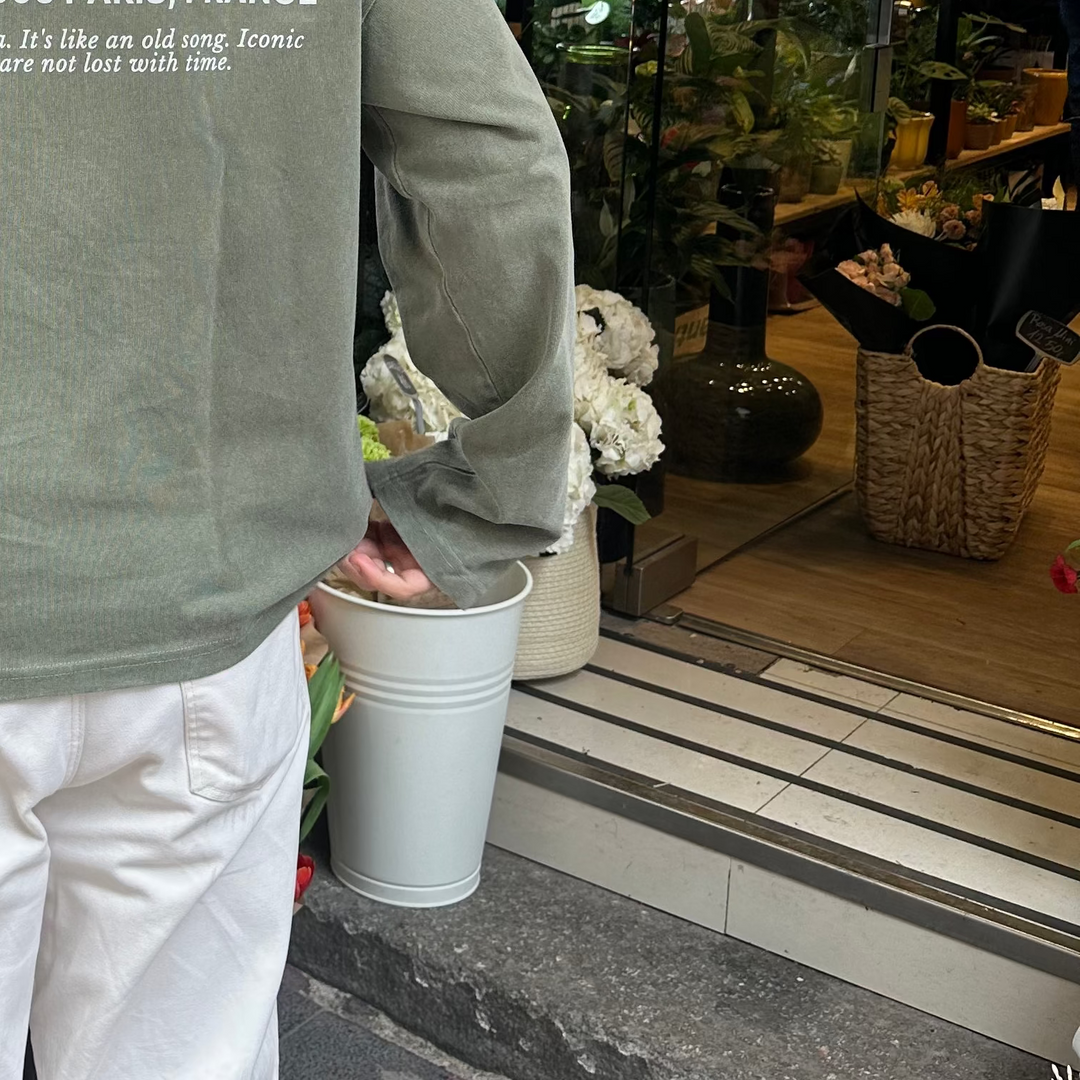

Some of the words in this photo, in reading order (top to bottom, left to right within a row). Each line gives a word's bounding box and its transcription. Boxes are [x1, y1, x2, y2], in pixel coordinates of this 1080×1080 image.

[18, 27, 53, 50] It's
[59, 27, 100, 50] like
[105, 34, 134, 50] an
[142, 27, 176, 50] old
[181, 32, 230, 54] song.
[236, 27, 305, 49] Iconic
[0, 57, 35, 73] are
[40, 55, 77, 73] not
[83, 51, 123, 73] lost
[129, 51, 179, 73] with
[185, 50, 232, 72] time.
